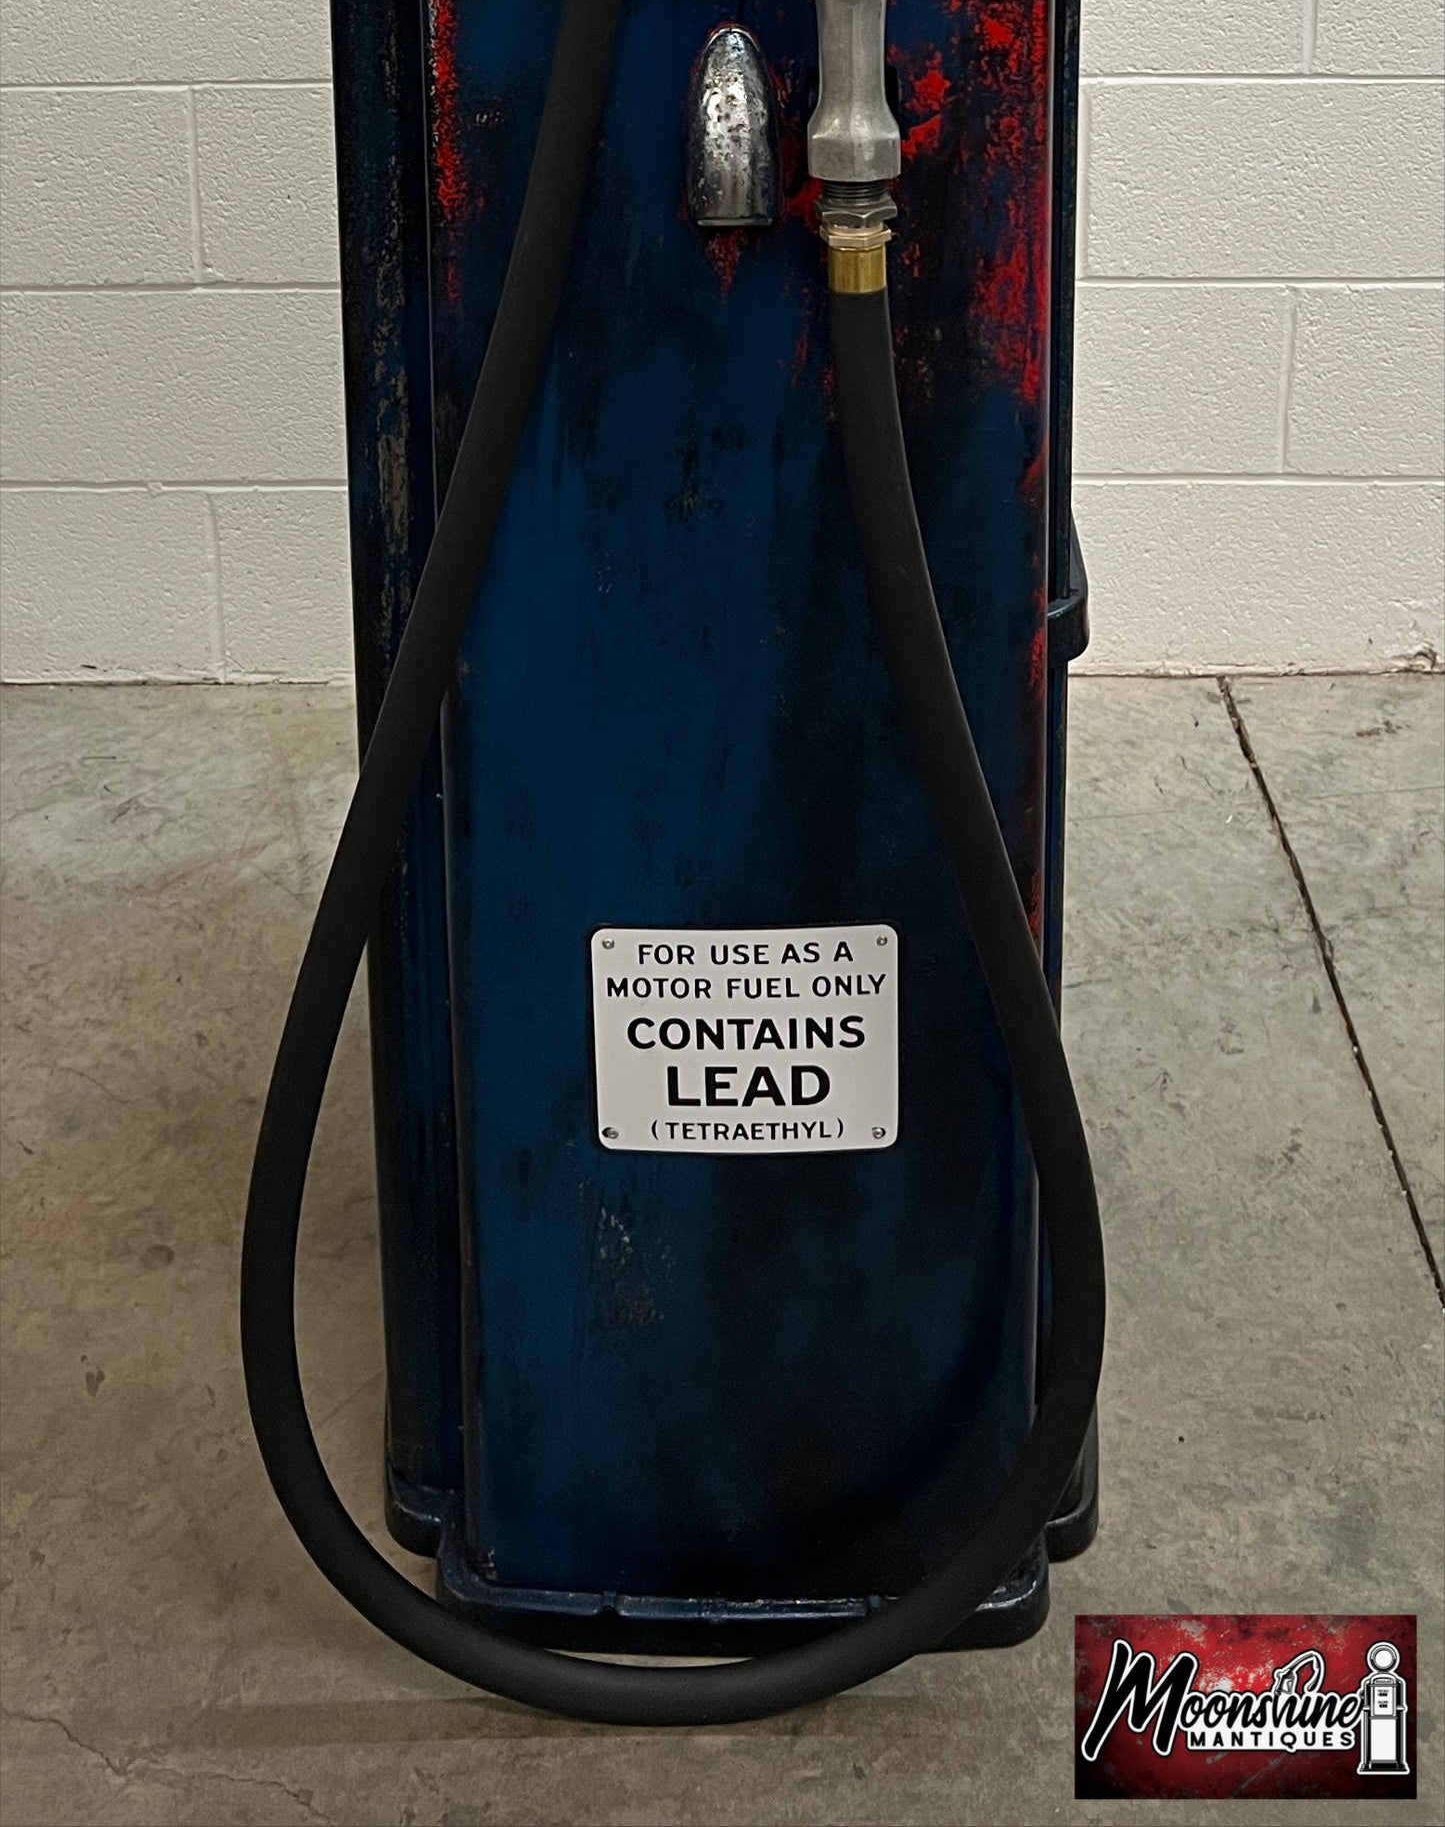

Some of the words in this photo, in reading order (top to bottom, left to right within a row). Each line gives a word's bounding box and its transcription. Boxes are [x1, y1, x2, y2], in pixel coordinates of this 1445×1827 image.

[638, 943, 695, 965] FOR
[710, 943, 770, 965] USE
[781, 942, 821, 964] AS
[833, 941, 854, 962] A
[606, 977, 712, 999] MOTOR
[727, 977, 800, 999] FUEL
[812, 973, 887, 997] ONLY
[626, 1015, 866, 1050] CONTAINS
[666, 1065, 831, 1107] LEAD
